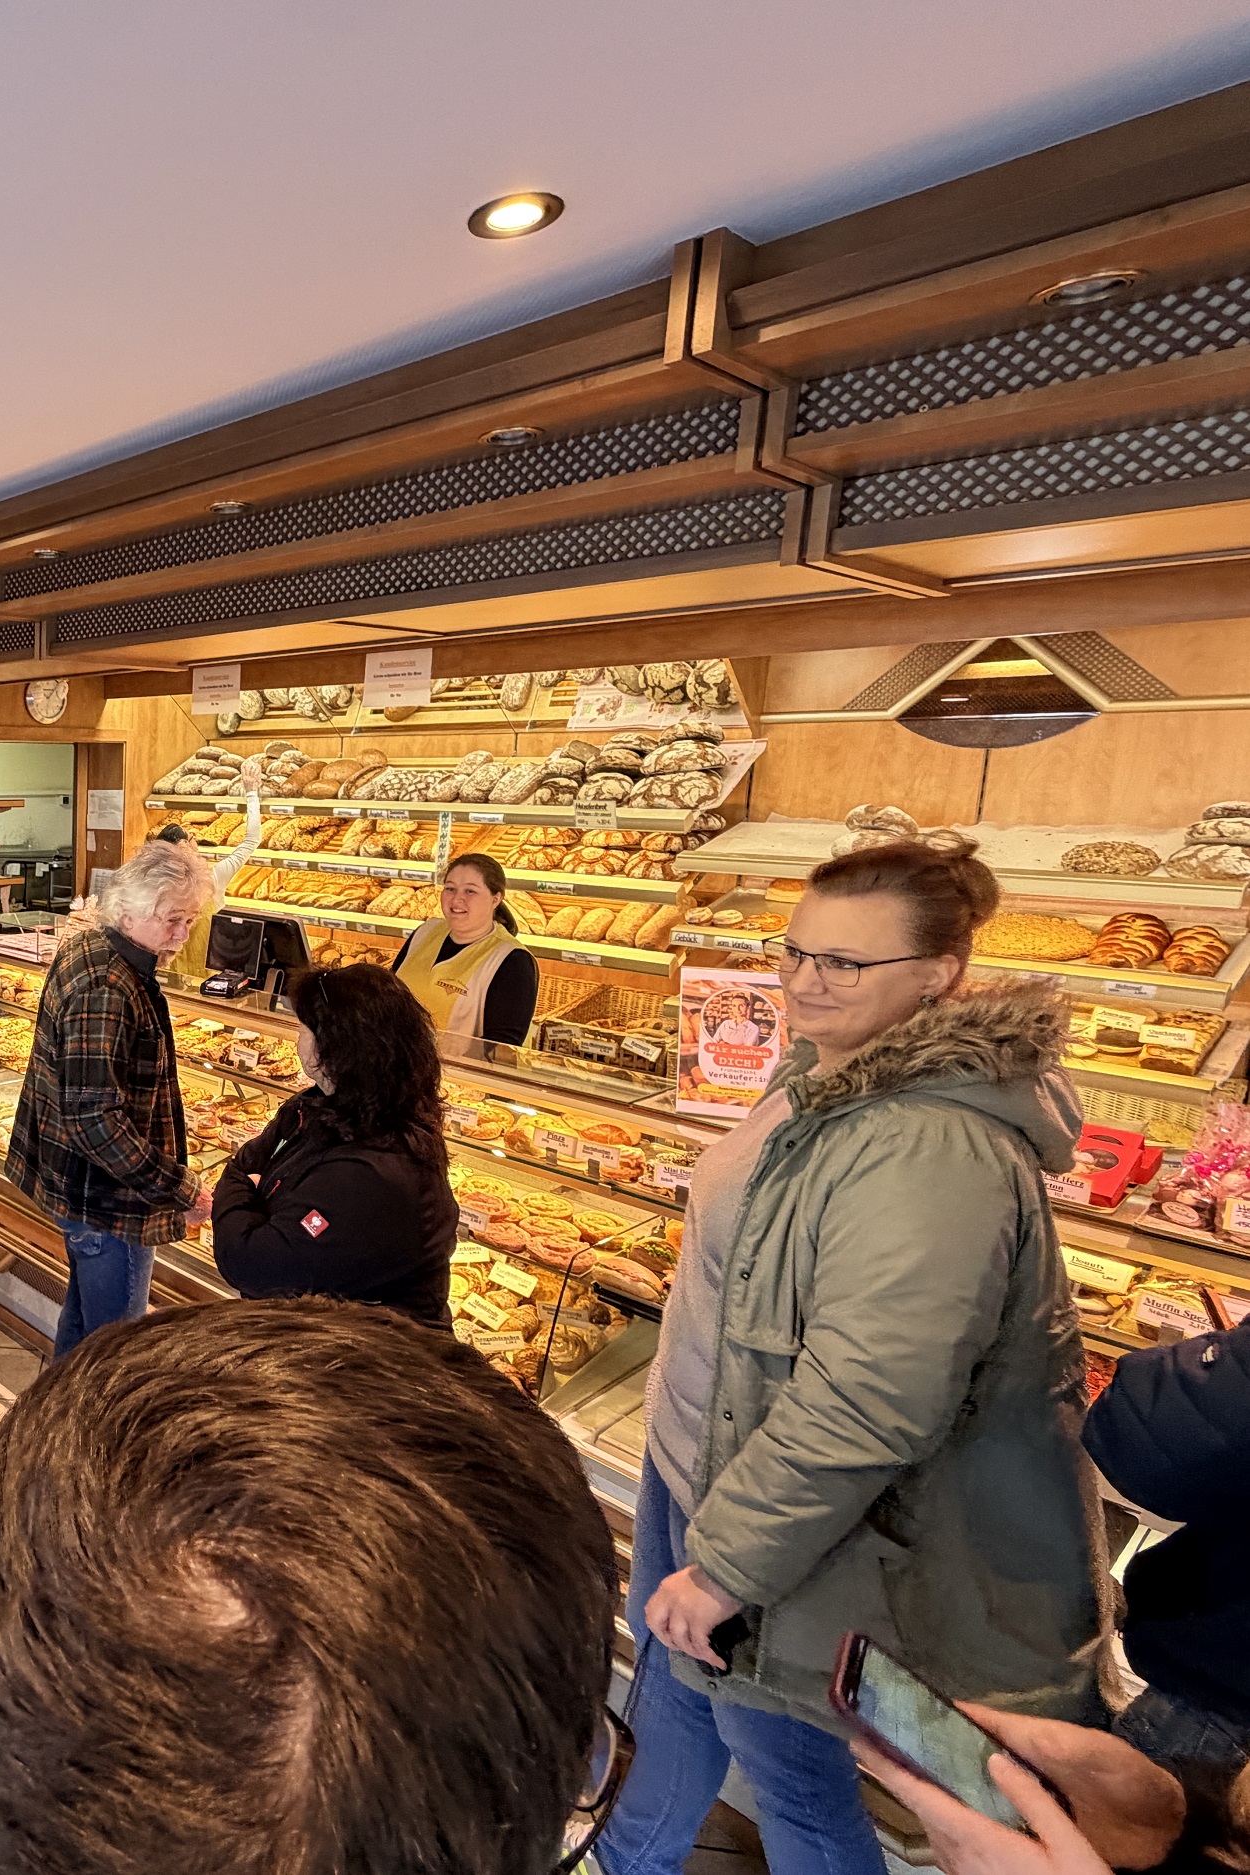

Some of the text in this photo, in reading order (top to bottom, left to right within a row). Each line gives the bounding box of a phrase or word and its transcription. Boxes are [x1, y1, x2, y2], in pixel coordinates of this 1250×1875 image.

[731, 941, 754, 952] Vortag
[708, 1045, 770, 1057] Wir suchen
[719, 1057, 757, 1068] DICH!
[547, 1131, 566, 1142] Pinza
[1062, 1176, 1085, 1188] Herz
[1071, 1255, 1105, 1271] Donuts
[1145, 1297, 1213, 1325] Muffin Spez
[1147, 1307, 1171, 1320] Stück
